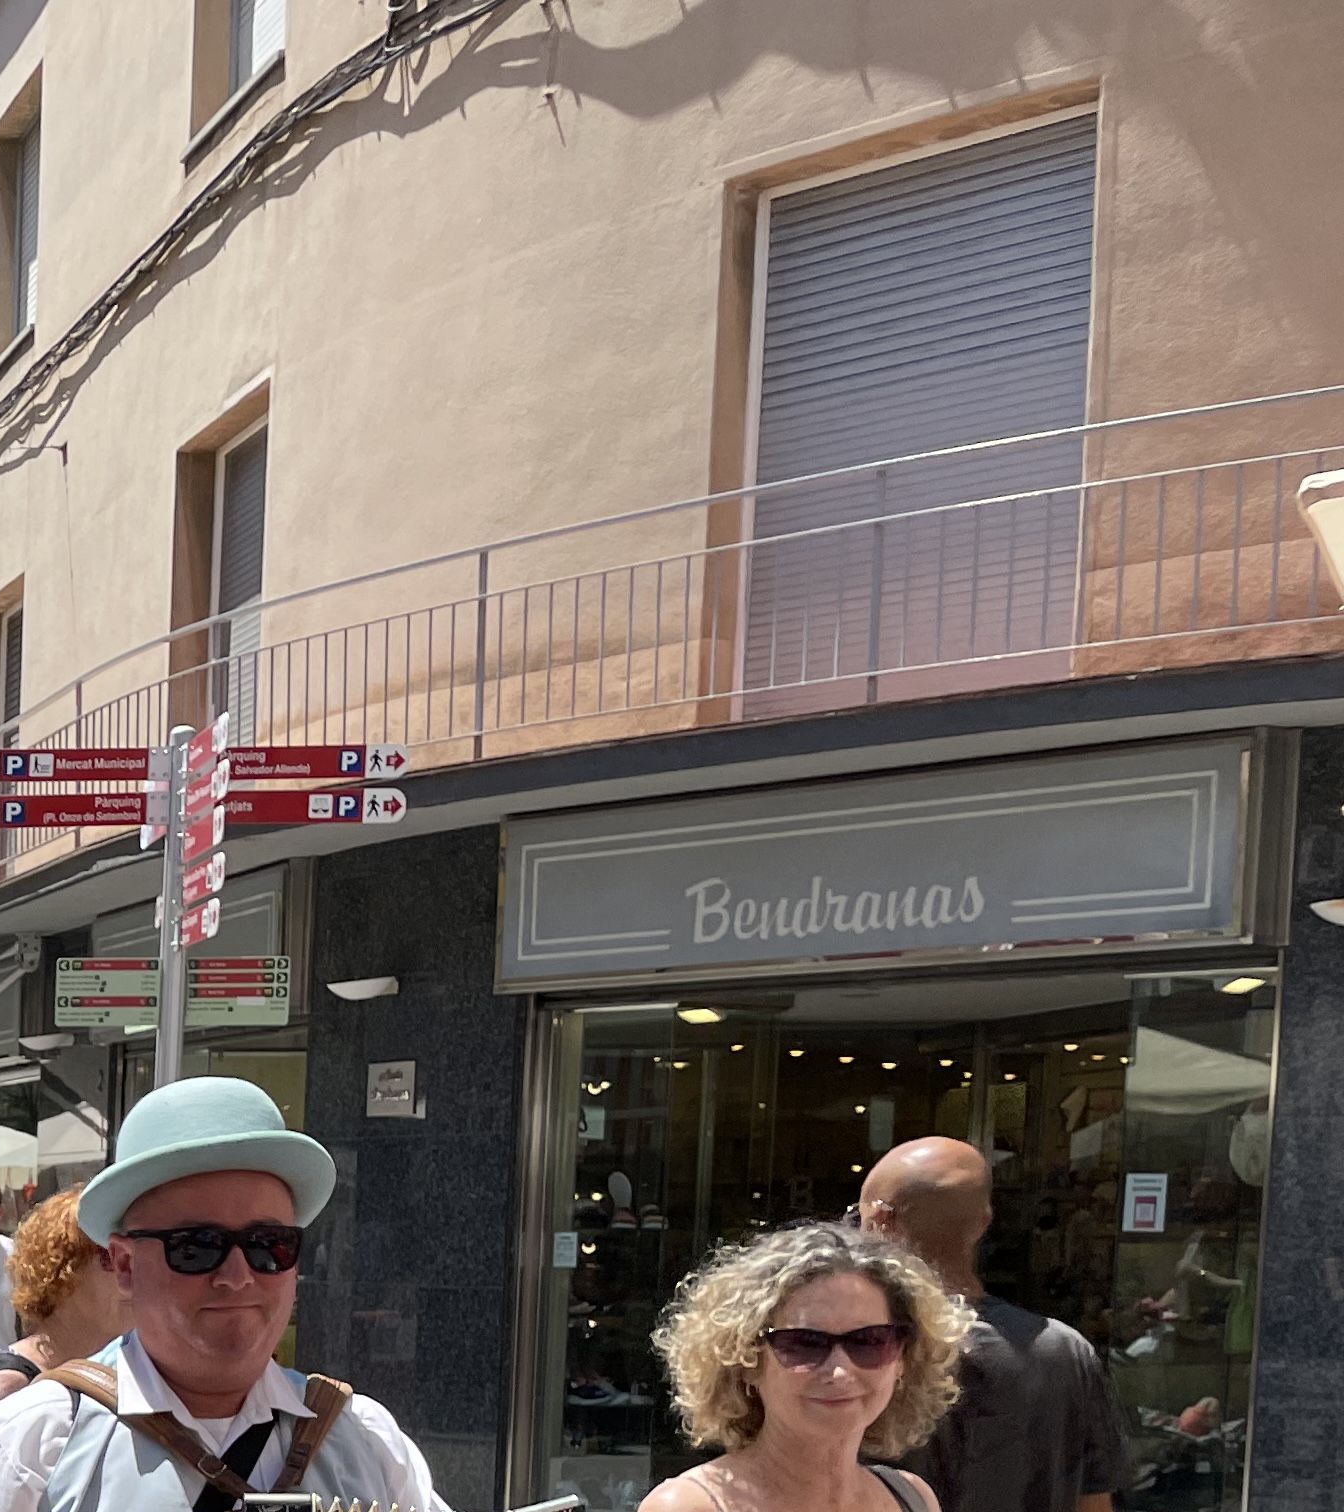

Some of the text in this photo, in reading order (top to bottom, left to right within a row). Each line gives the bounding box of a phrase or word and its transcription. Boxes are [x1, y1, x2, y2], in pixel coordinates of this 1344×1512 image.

[56, 758, 92, 769] Mercat
[94, 757, 145, 770] Municipal
[685, 876, 985, 944] Bendranas
